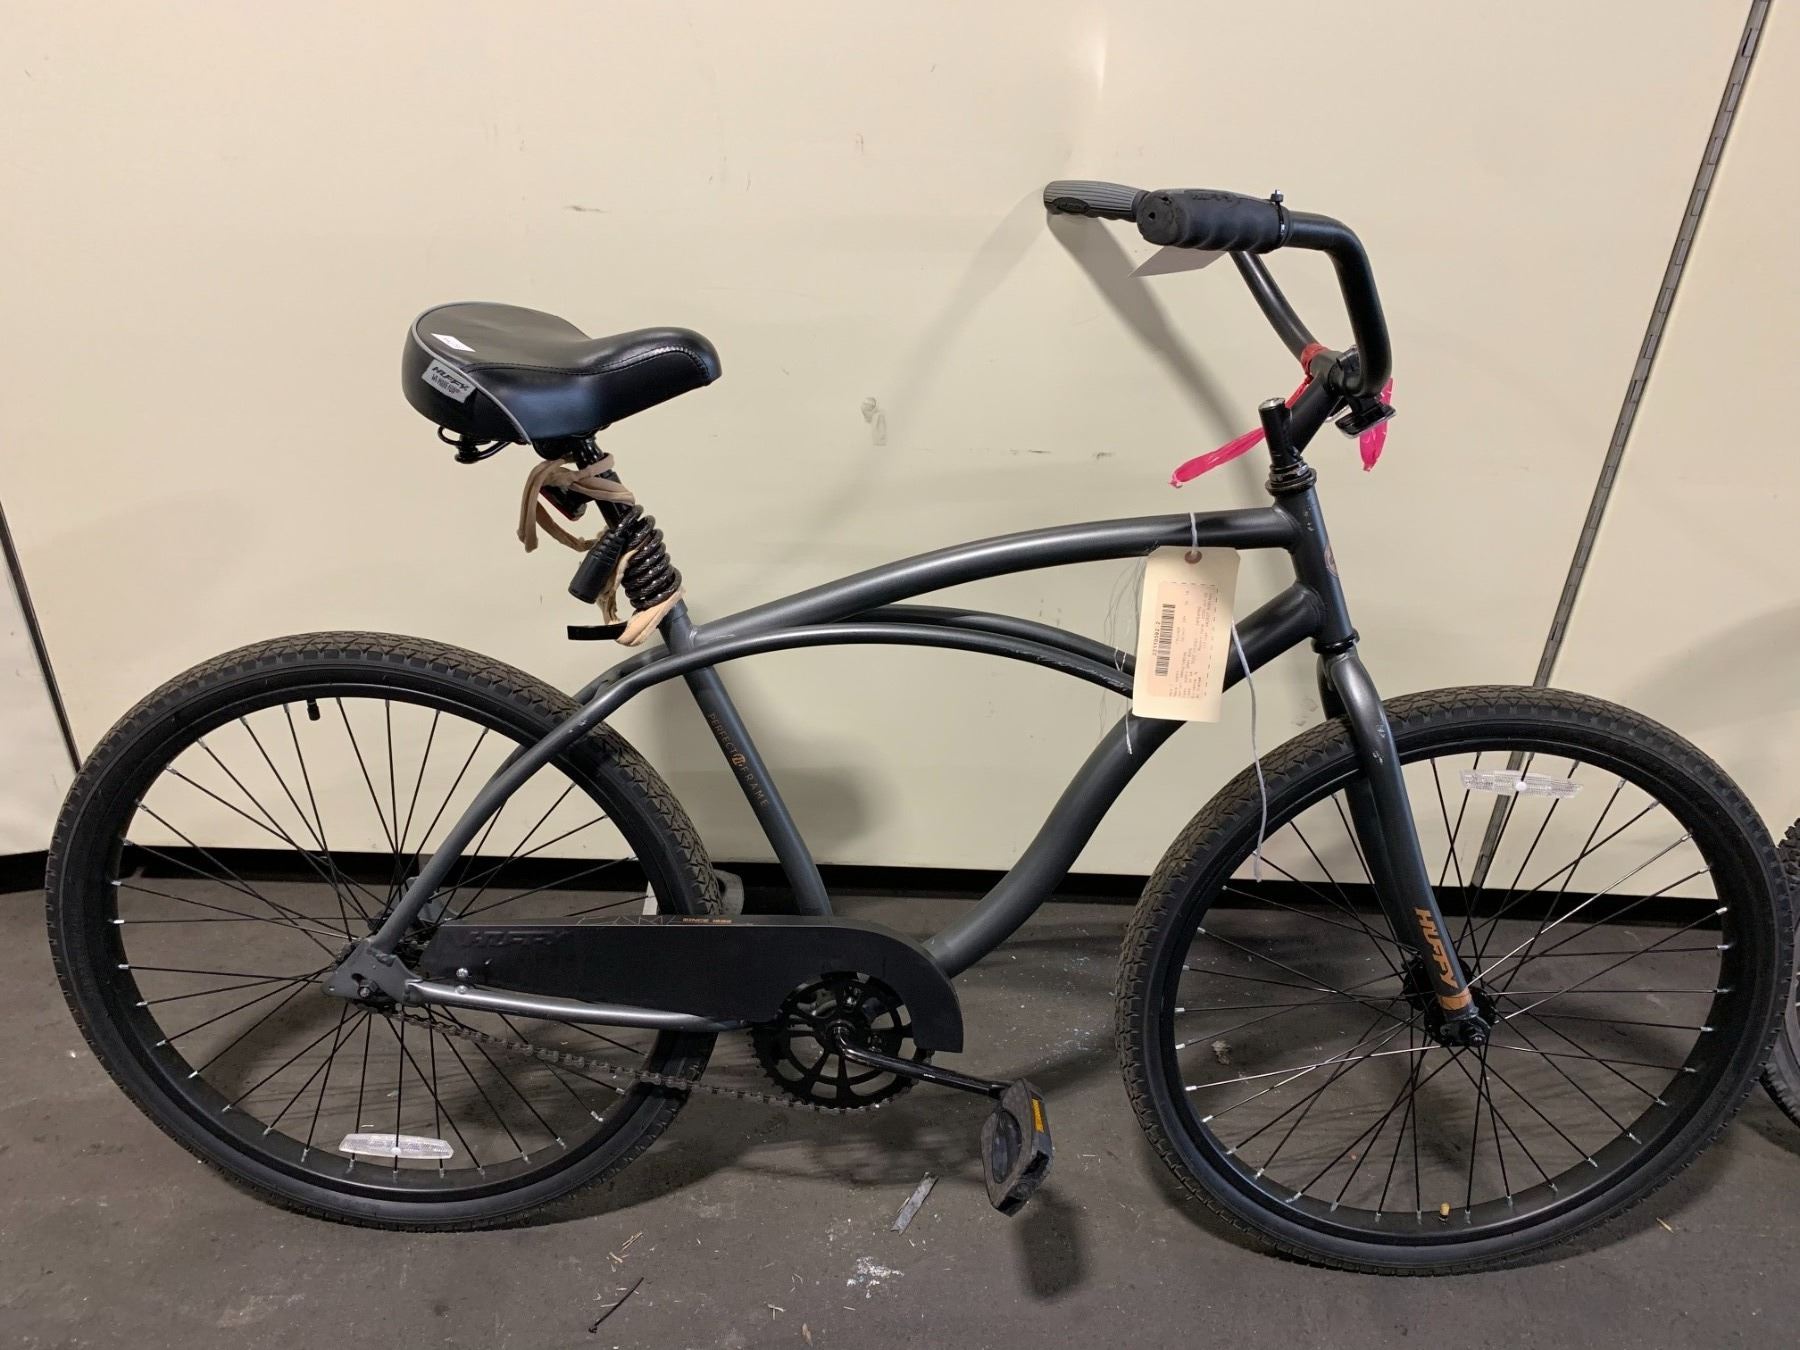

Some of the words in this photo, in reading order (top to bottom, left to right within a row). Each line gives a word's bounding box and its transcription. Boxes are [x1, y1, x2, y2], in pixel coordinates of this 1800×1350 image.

[432, 366, 469, 391] HUFFY
[707, 713, 738, 754] PERFECT
[740, 766, 770, 806] FRAME
[1413, 908, 1459, 989] HUFFY
